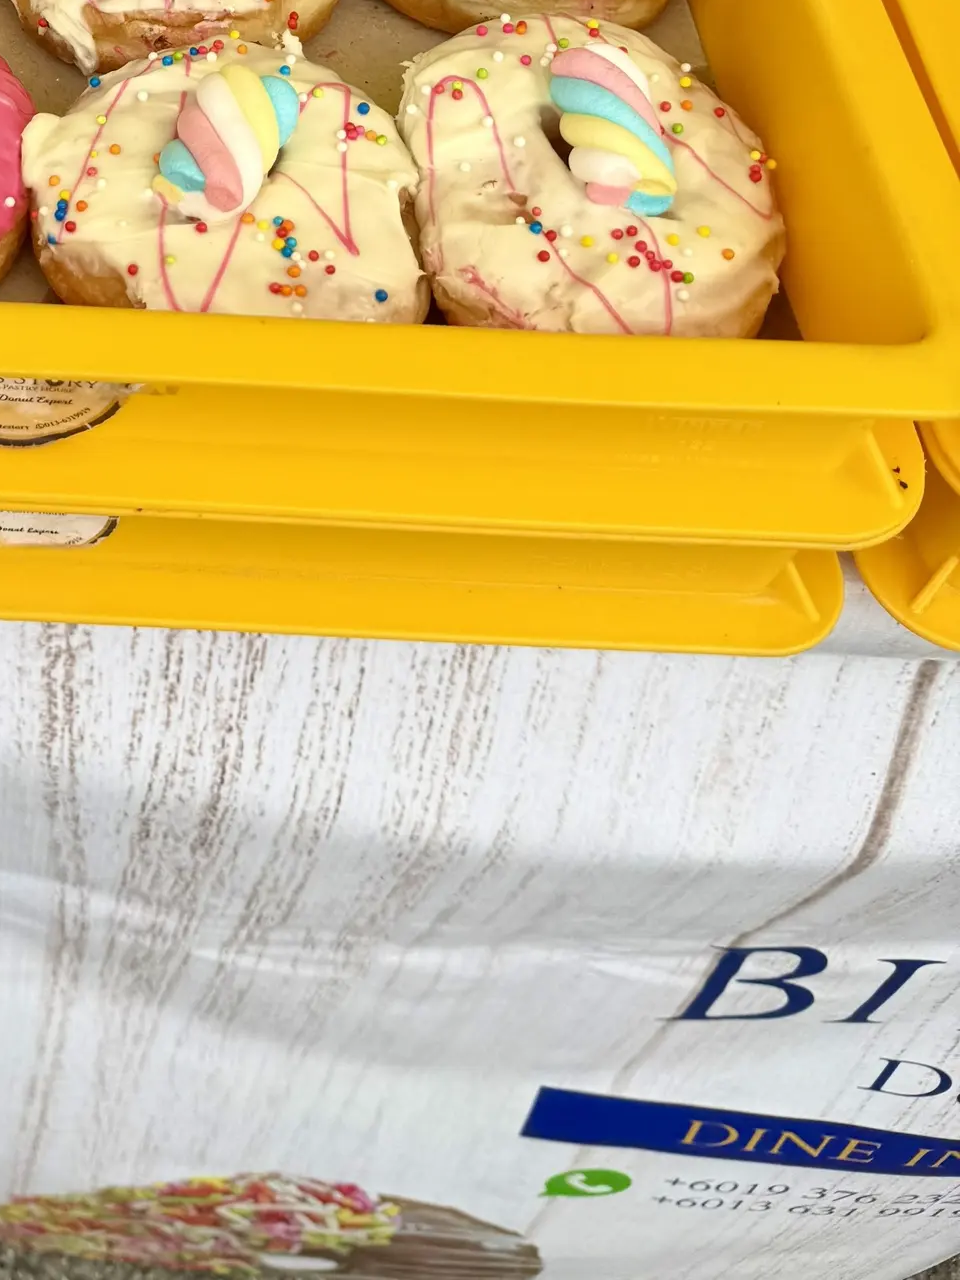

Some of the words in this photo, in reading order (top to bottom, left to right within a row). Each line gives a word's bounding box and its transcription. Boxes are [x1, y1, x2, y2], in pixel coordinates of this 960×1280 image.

[36, 395, 74, 406] Expert
[678, 1118, 882, 1164] DINE
[665, 1176, 790, 1196] +6019
[802, 1186, 878, 1204] 376
[652, 1195, 772, 1212] +6013
